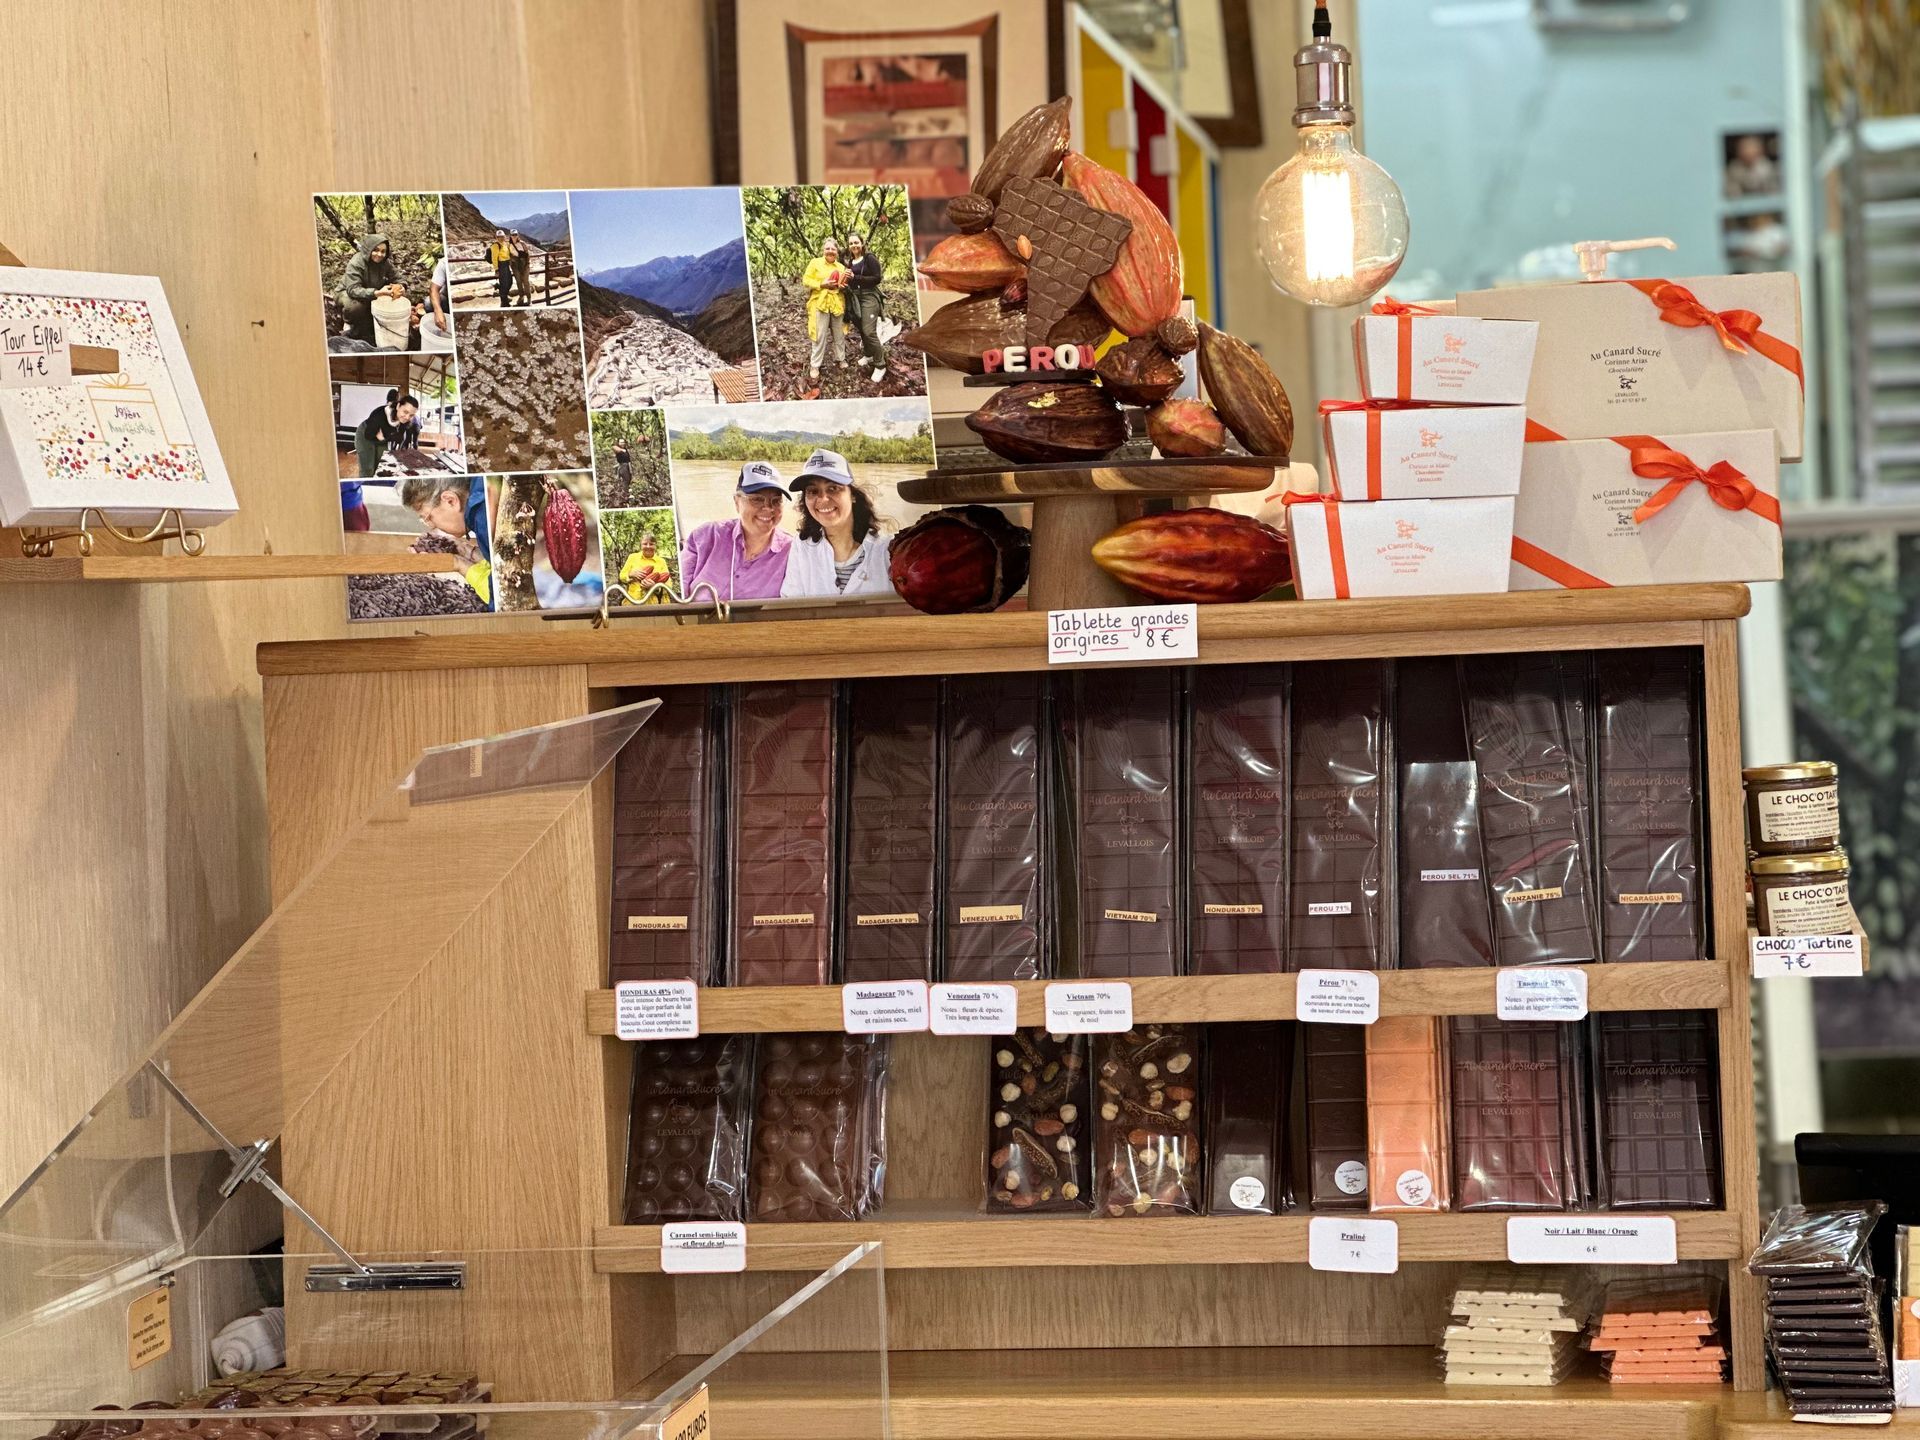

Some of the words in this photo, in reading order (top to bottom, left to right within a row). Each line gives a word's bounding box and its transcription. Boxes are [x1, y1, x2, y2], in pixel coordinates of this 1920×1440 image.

[1, 327, 26, 351] Tour
[33, 325, 63, 355] Eiffel
[1590, 353, 1601, 361] Au
[1603, 346, 1635, 358] Canard
[1636, 346, 1661, 358] Sucré
[982, 343, 1096, 374] PEROU
[1592, 493, 1602, 501] Au
[1603, 488, 1630, 498] Canard
[1050, 612, 1122, 632] Tablette
[1132, 610, 1189, 638] grandes
[1054, 632, 1119, 656] origines
[1146, 628, 1155, 648] 8
[1161, 628, 1179, 648] €
[1772, 796, 1783, 805] LE
[1107, 839, 1154, 848] LEVALLOIS
[1620, 894, 1665, 902] NICARAGUA
[1778, 892, 1789, 901] LE
[1309, 905, 1334, 913] PEROU
[1106, 912, 1139, 921] VIETNAM
[1804, 937, 1853, 949] Tartine
[856, 991, 896, 999] Madagascar
[1628, 1064, 1668, 1076] Canard
[1481, 1107, 1530, 1116] LEVALLOIS
[1632, 1111, 1682, 1120] LEVALLOIS
[699, 1231, 738, 1239] semi-liquide
[1341, 1232, 1366, 1240] Praliné
[1612, 1227, 1639, 1236] Orange
[687, 1410, 707, 1440] EUROS
